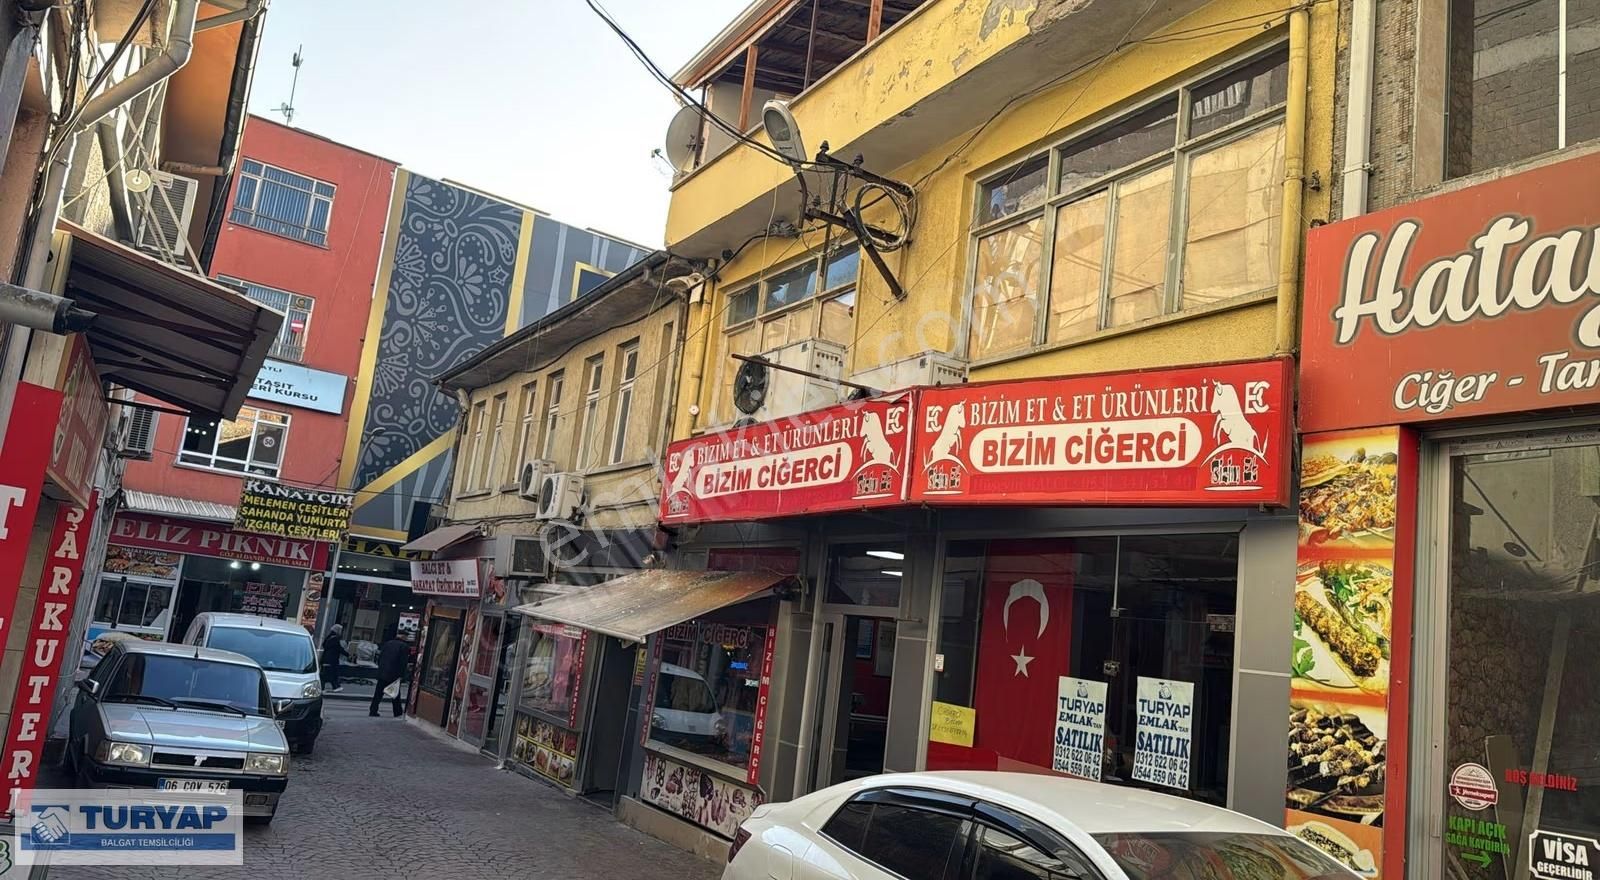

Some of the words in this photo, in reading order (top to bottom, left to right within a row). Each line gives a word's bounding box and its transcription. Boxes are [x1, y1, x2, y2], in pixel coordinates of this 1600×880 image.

[274, 388, 319, 402] KURSU
[970, 394, 1020, 426] BİZİM
[1026, 397, 1047, 424] ET
[1052, 397, 1066, 423] &
[1072, 394, 1095, 420] ET
[1101, 379, 1208, 418] ÜRÜNLERİ
[1394, 370, 1497, 414] Ciğer
[697, 440, 731, 465] BİZİM
[733, 441, 747, 459] ET
[751, 439, 761, 457] &
[764, 432, 779, 453] ET
[783, 409, 858, 449] ÜRÜNLERİ
[982, 432, 1056, 467] BİZİM
[1065, 422, 1187, 465] CİĞERCİ
[703, 464, 750, 494] BİZİM
[757, 447, 842, 488] CİĞERCİ
[246, 480, 353, 506] KANATÇIM
[241, 506, 293, 522] SAHANDA
[297, 515, 347, 529] YUMURTA
[244, 495, 296, 510] MELEMEN
[299, 503, 349, 517] ÇEŞİTLERİ
[113, 518, 191, 550] ELİZ
[200, 529, 310, 560] PİKNİK
[245, 519, 285, 532] IZGARA
[288, 524, 340, 539] ÇEŞİTLERİ
[1060, 697, 1104, 715] TURYAP
[1139, 698, 1190, 718] TURYAP
[1059, 711, 1093, 728] EMLAK
[1138, 715, 1179, 731] EMLAK
[1056, 727, 1102, 753] SATILIK
[1137, 731, 1190, 759] SATILIK
[1055, 745, 1070, 759] 0312
[1071, 749, 1083, 762] 622
[1084, 752, 1092, 764] 06
[1093, 754, 1100, 766] 42
[1135, 751, 1153, 766] 0312
[1154, 755, 1167, 768] 622
[1168, 759, 1178, 771] 06
[1179, 761, 1188, 774] 42
[1054, 758, 1069, 771] 0544
[1070, 762, 1082, 775] 559
[1083, 765, 1091, 777] 06
[1092, 767, 1100, 779] 42
[1134, 766, 1151, 780] 0544
[1152, 769, 1166, 783] 559
[1168, 773, 1176, 785] 06
[1178, 775, 1187, 788] 42
[1446, 832, 1467, 846] SAĞA
[1449, 816, 1475, 833] KAPI
[1478, 820, 1506, 840] AÇIK
[1543, 838, 1589, 866] VİSA
[1537, 861, 1593, 880] GEÇERLİDİR
